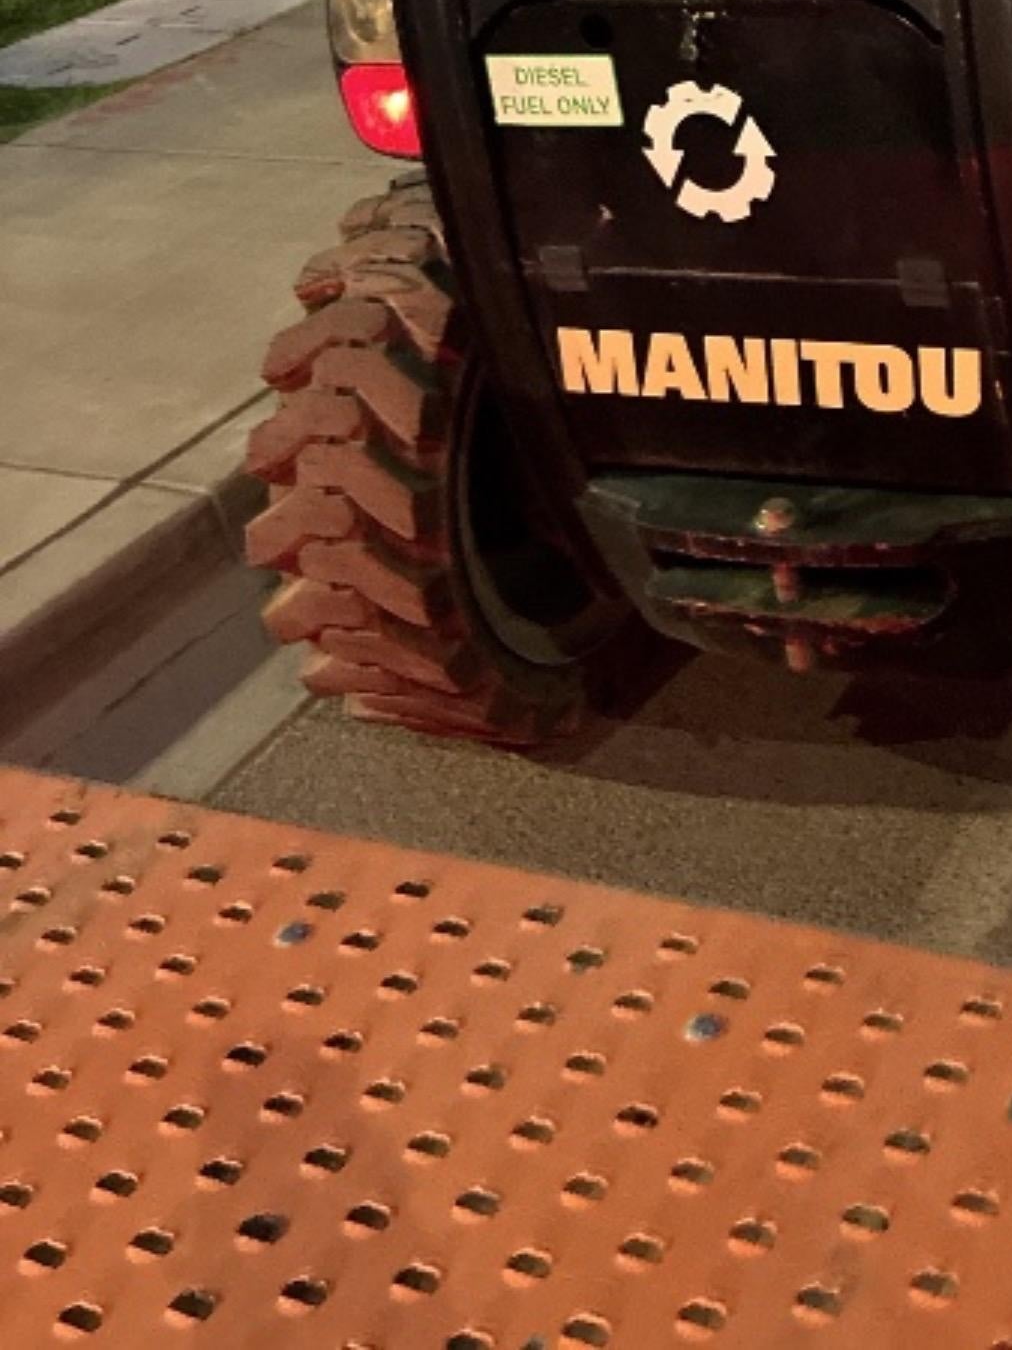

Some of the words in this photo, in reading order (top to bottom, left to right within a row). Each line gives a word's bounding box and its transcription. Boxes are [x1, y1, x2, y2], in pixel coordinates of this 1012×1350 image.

[514, 66, 588, 87] DIESEL
[500, 95, 552, 114] FUEL
[557, 95, 610, 114] ONLY
[557, 327, 982, 417] MANITOU
